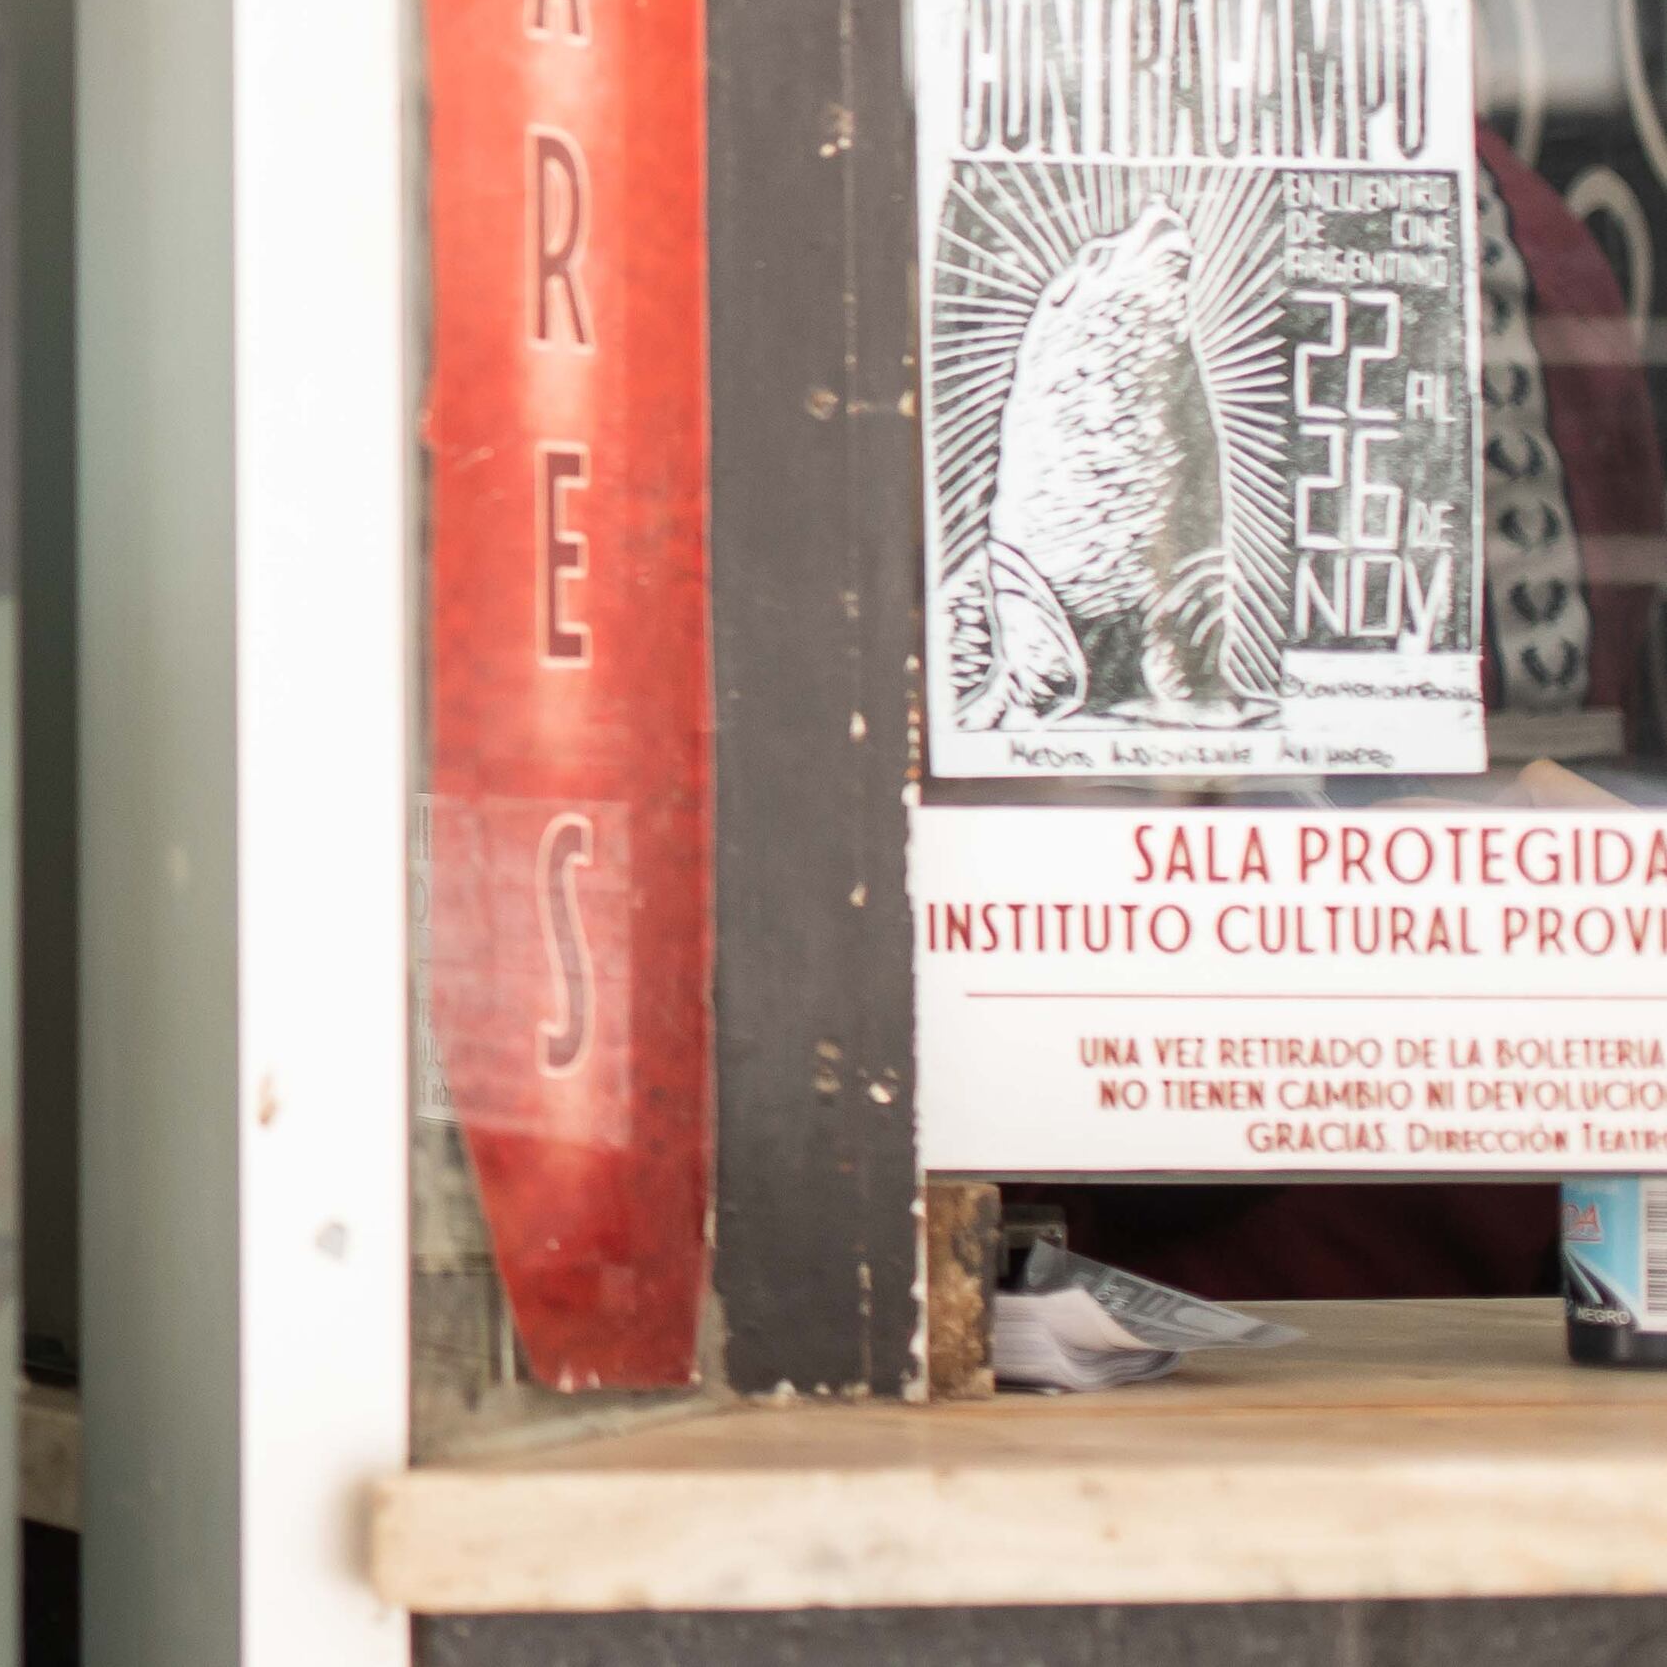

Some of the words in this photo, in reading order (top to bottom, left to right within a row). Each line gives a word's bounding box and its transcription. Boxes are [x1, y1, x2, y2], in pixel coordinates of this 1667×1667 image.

[1284, 210, 1326, 244] DE
[1293, 290, 1402, 421] 22
[1406, 369, 1457, 423] AL
[1295, 423, 1404, 550] 26
[1406, 497, 1456, 549] DE
[1134, 825, 1270, 883] SALA
[1299, 826, 1667, 886] PROTEGIDA
[927, 903, 1192, 955] INSTITUTO
[1216, 906, 1480, 955] CULTURAL
[1080, 1037, 1141, 1068] UNA
[1155, 1037, 1205, 1068] VEZ
[1219, 1037, 1383, 1068] RETIRADO
[1395, 1038, 1437, 1068] DE
[1449, 1038, 1483, 1069] LA
[1100, 1079, 1148, 1110] NO
[1163, 1080, 1264, 1111] TIENEN
[1278, 1080, 1413, 1111] CAMBIO
[1426, 1080, 1455, 1111] NI
[1467, 1081, 1666, 1111] DEVOLUCIO
[1577, 1306, 1631, 1326] NEGRO
